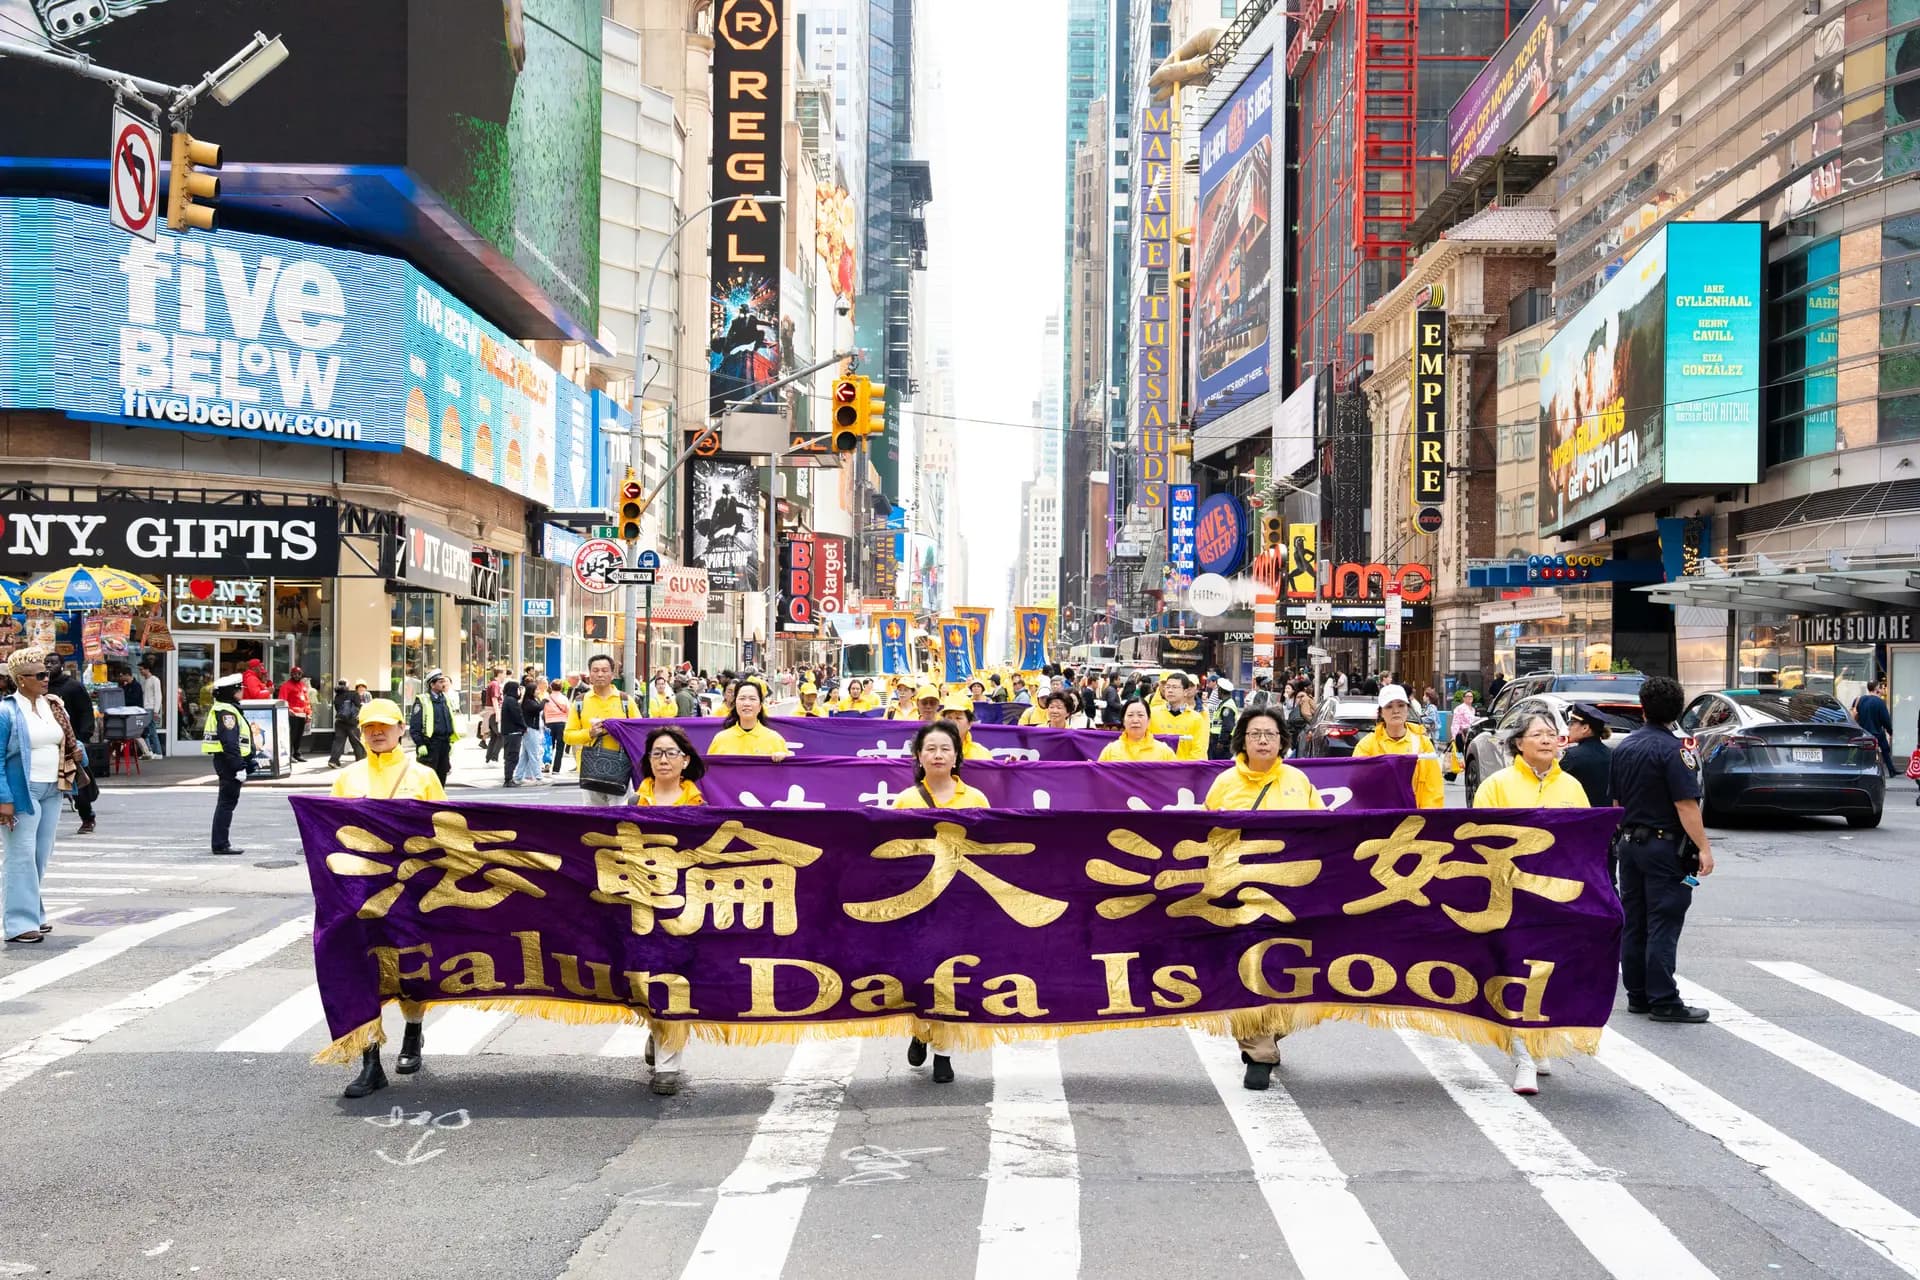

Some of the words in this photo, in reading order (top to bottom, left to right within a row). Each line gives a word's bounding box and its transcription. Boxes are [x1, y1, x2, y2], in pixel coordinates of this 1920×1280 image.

[1477, 102, 1490, 134] OFF
[1491, 72, 1514, 113] MOVIE
[1515, 16, 1547, 78] TICKETS
[726, 71, 768, 263] REGAL
[1143, 109, 1168, 265] MADAME
[120, 235, 345, 349] five
[1676, 296, 1752, 307] GYLLENHAAL
[1693, 330, 1734, 341] CAVILL
[1699, 319, 1729, 328] HENRY
[1702, 354, 1723, 362] EIZA
[123, 388, 362, 440] fivebelow.com
[1143, 296, 1165, 506] TUSSAUDS
[1419, 323, 1444, 492] EMPIRE
[1568, 472, 1583, 502] GET
[1586, 430, 1638, 494] STOLEN
[1172, 506, 1194, 521] EAT
[126, 517, 317, 561] GIFTS
[442, 542, 470, 584] GIFTS
[790, 542, 811, 624] BBQ
[823, 542, 840, 596] target
[25, 597, 61, 608] SABRETT
[175, 576, 187, 599] I
[528, 601, 548, 610] five
[669, 577, 707, 594] GUYS
[175, 605, 263, 627] GIFTS
[1805, 618, 1840, 642] TIMES
[1847, 616, 1910, 642] SQUARE
[326, 811, 1584, 936] 法輪大法好
[367, 931, 699, 1015] Falun
[738, 954, 1048, 1019] Dafa
[1091, 952, 1203, 1015] Is
[1237, 937, 1556, 1023] Good
